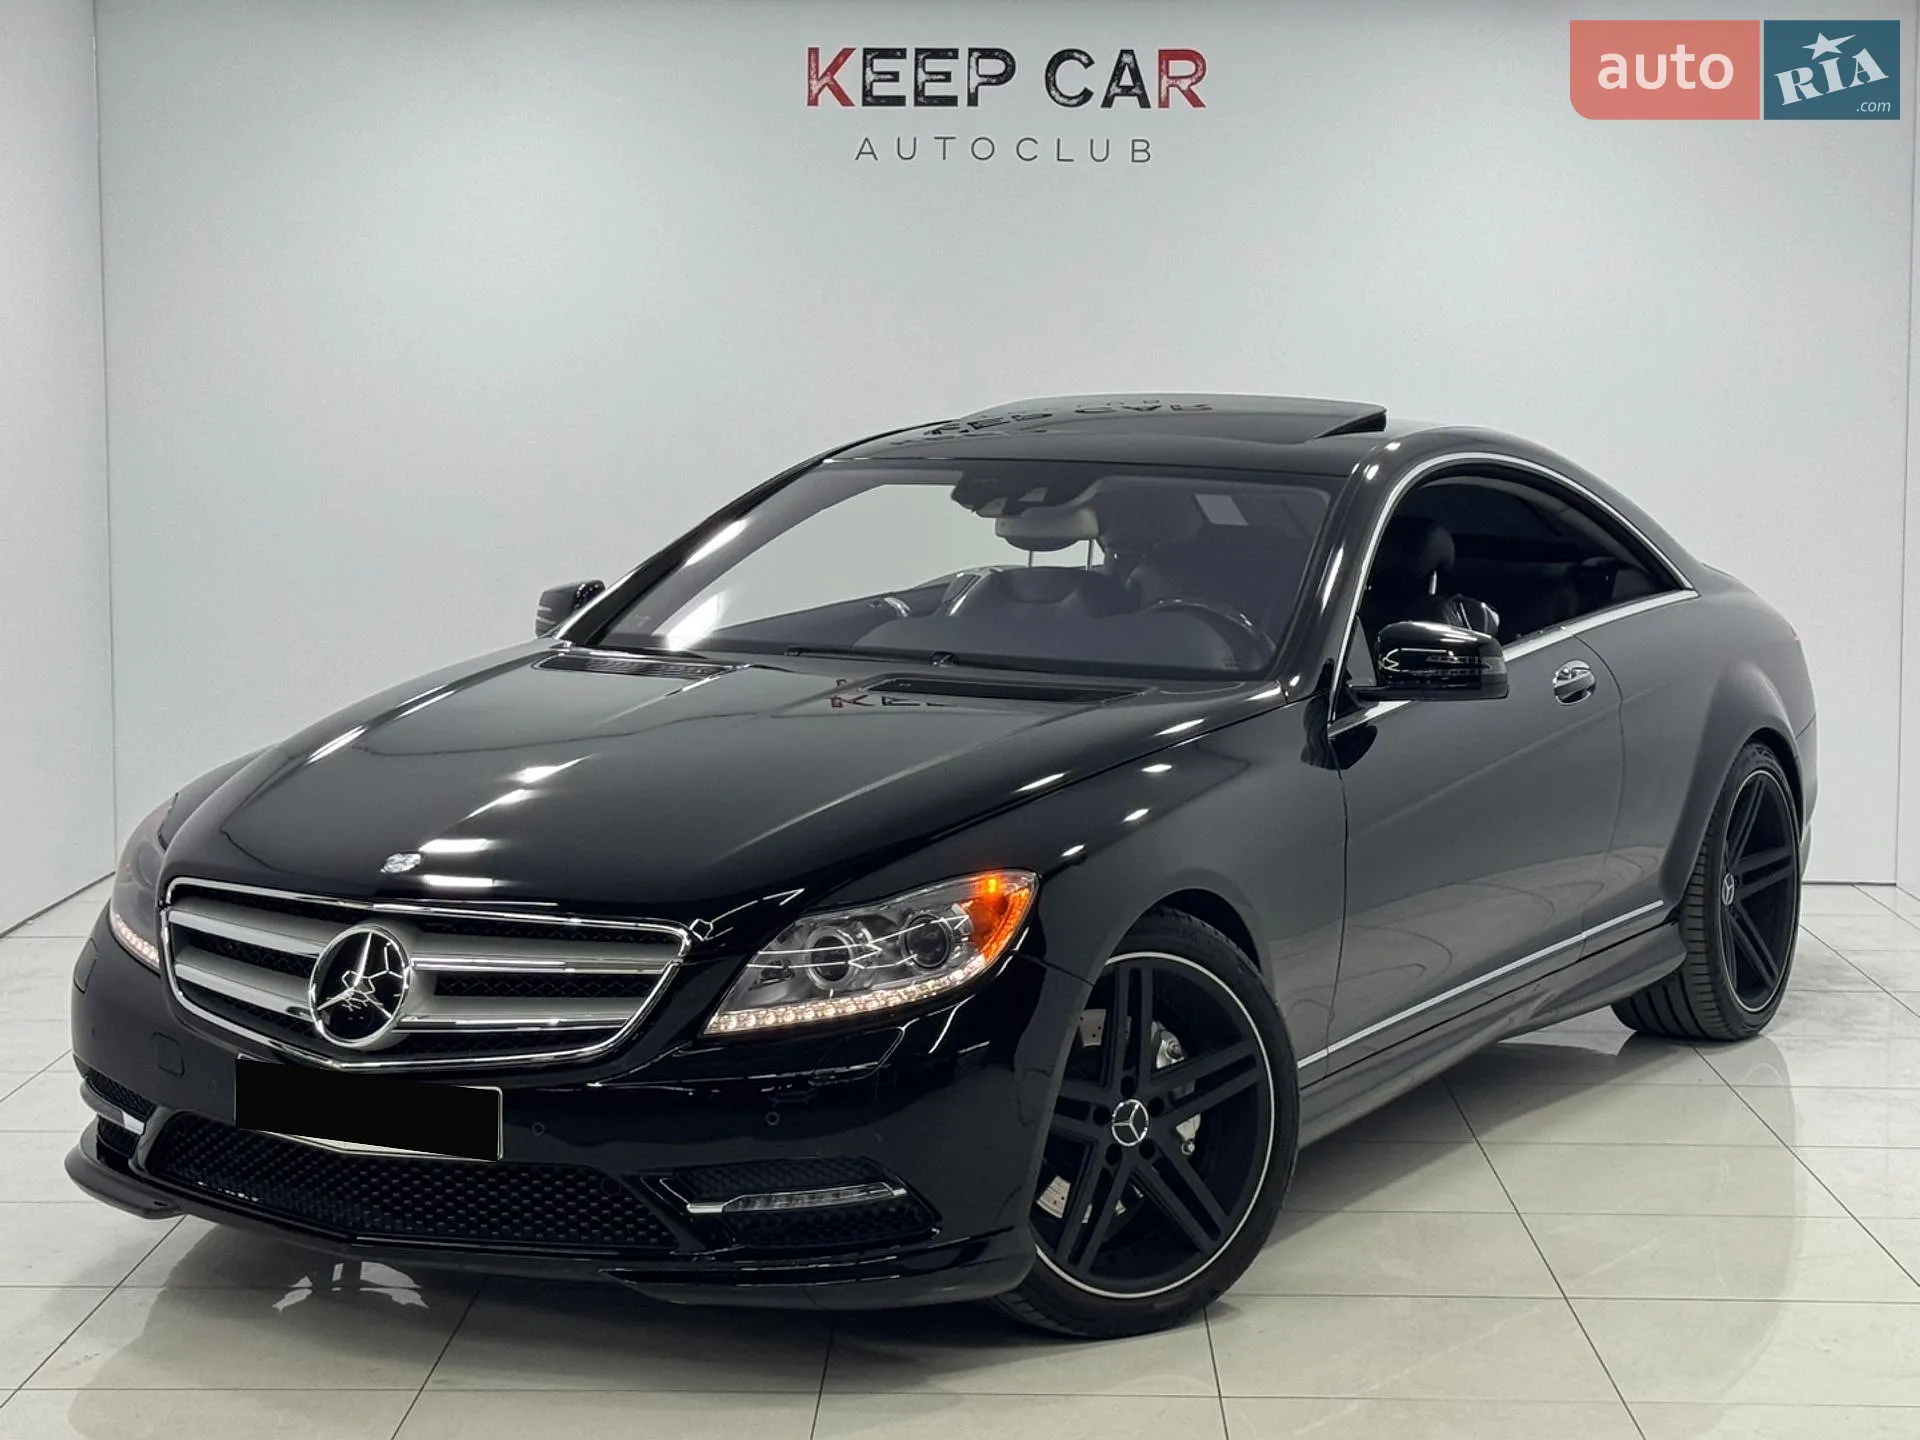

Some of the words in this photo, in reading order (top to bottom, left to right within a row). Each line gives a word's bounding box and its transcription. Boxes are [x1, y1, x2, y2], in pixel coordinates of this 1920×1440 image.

[806, 46, 1016, 108] KEEP
[1044, 48, 1208, 109] CAR
[855, 136, 1153, 163] AUTOCLUB
